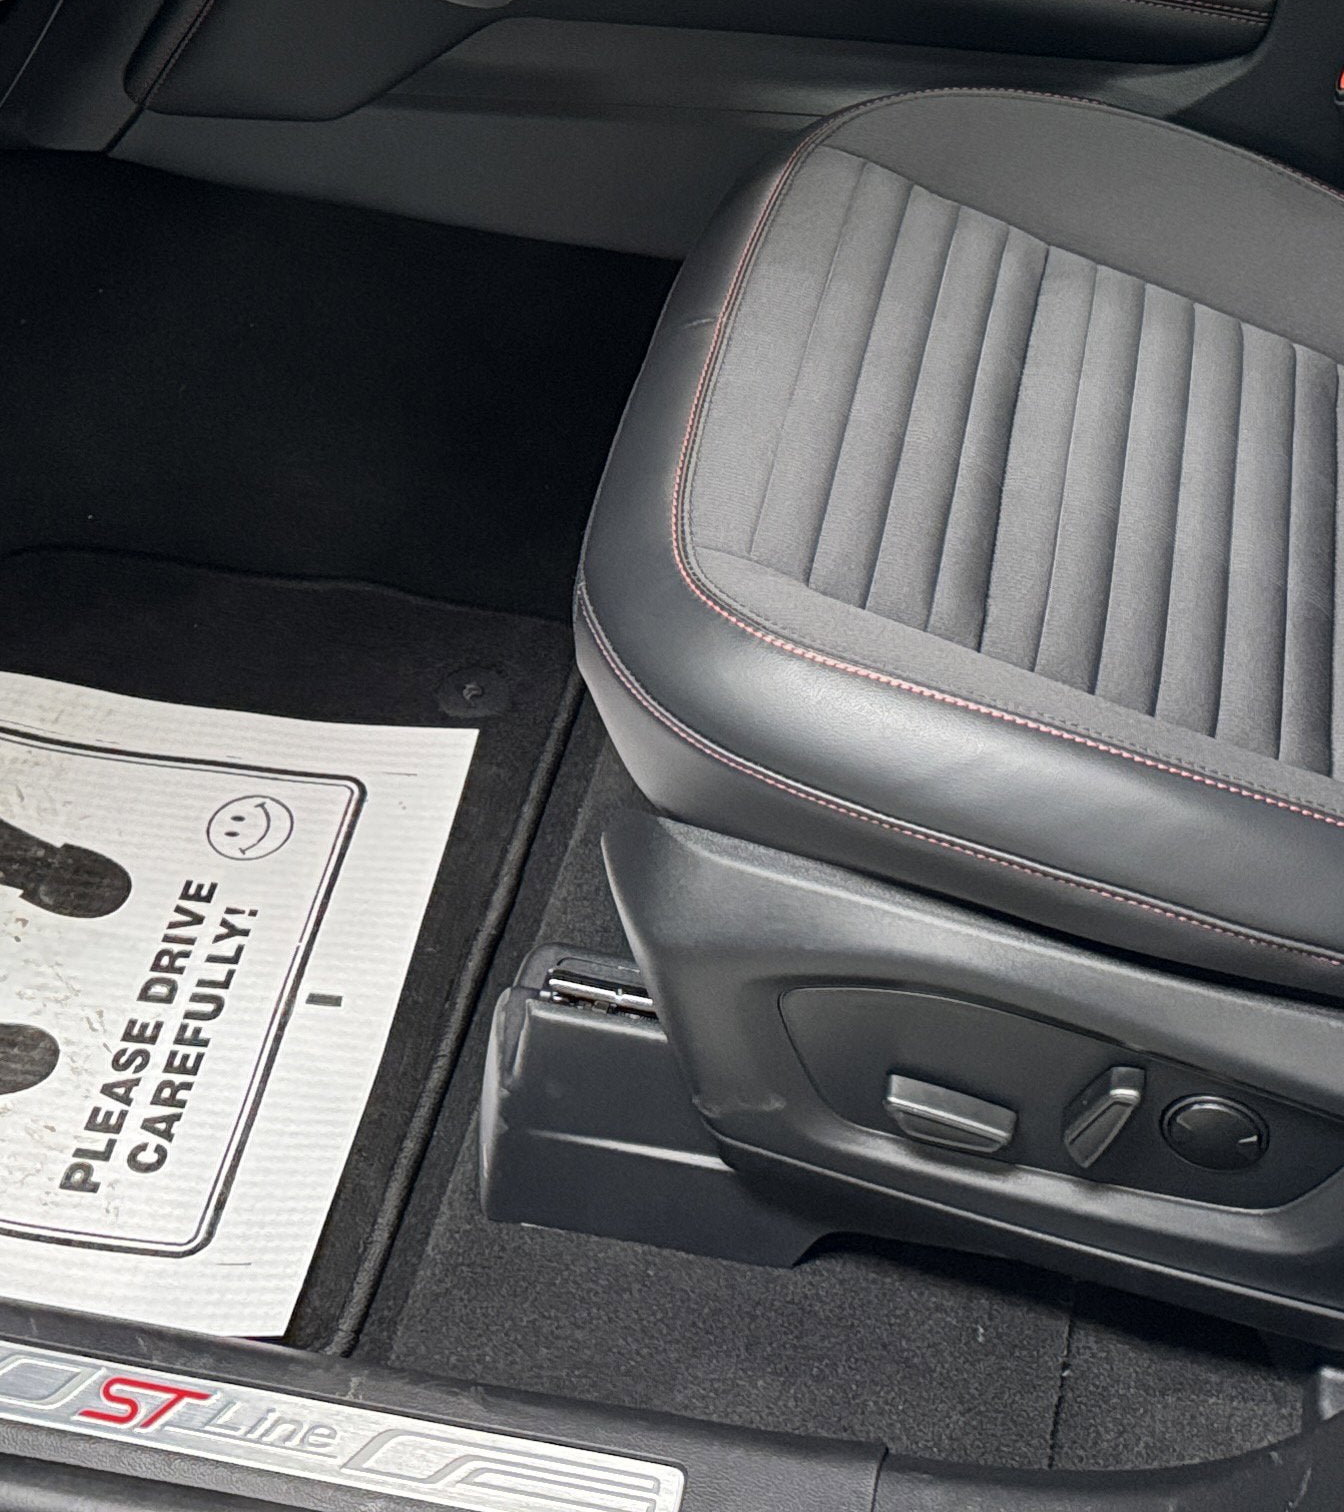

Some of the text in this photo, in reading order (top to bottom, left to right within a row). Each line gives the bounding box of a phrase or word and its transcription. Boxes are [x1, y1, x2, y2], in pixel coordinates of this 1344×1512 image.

[59, 879, 218, 1194] PLEASE DRIVE
[127, 906, 258, 1174] CAREFULLY!
[76, 1375, 339, 1451] ST Line
